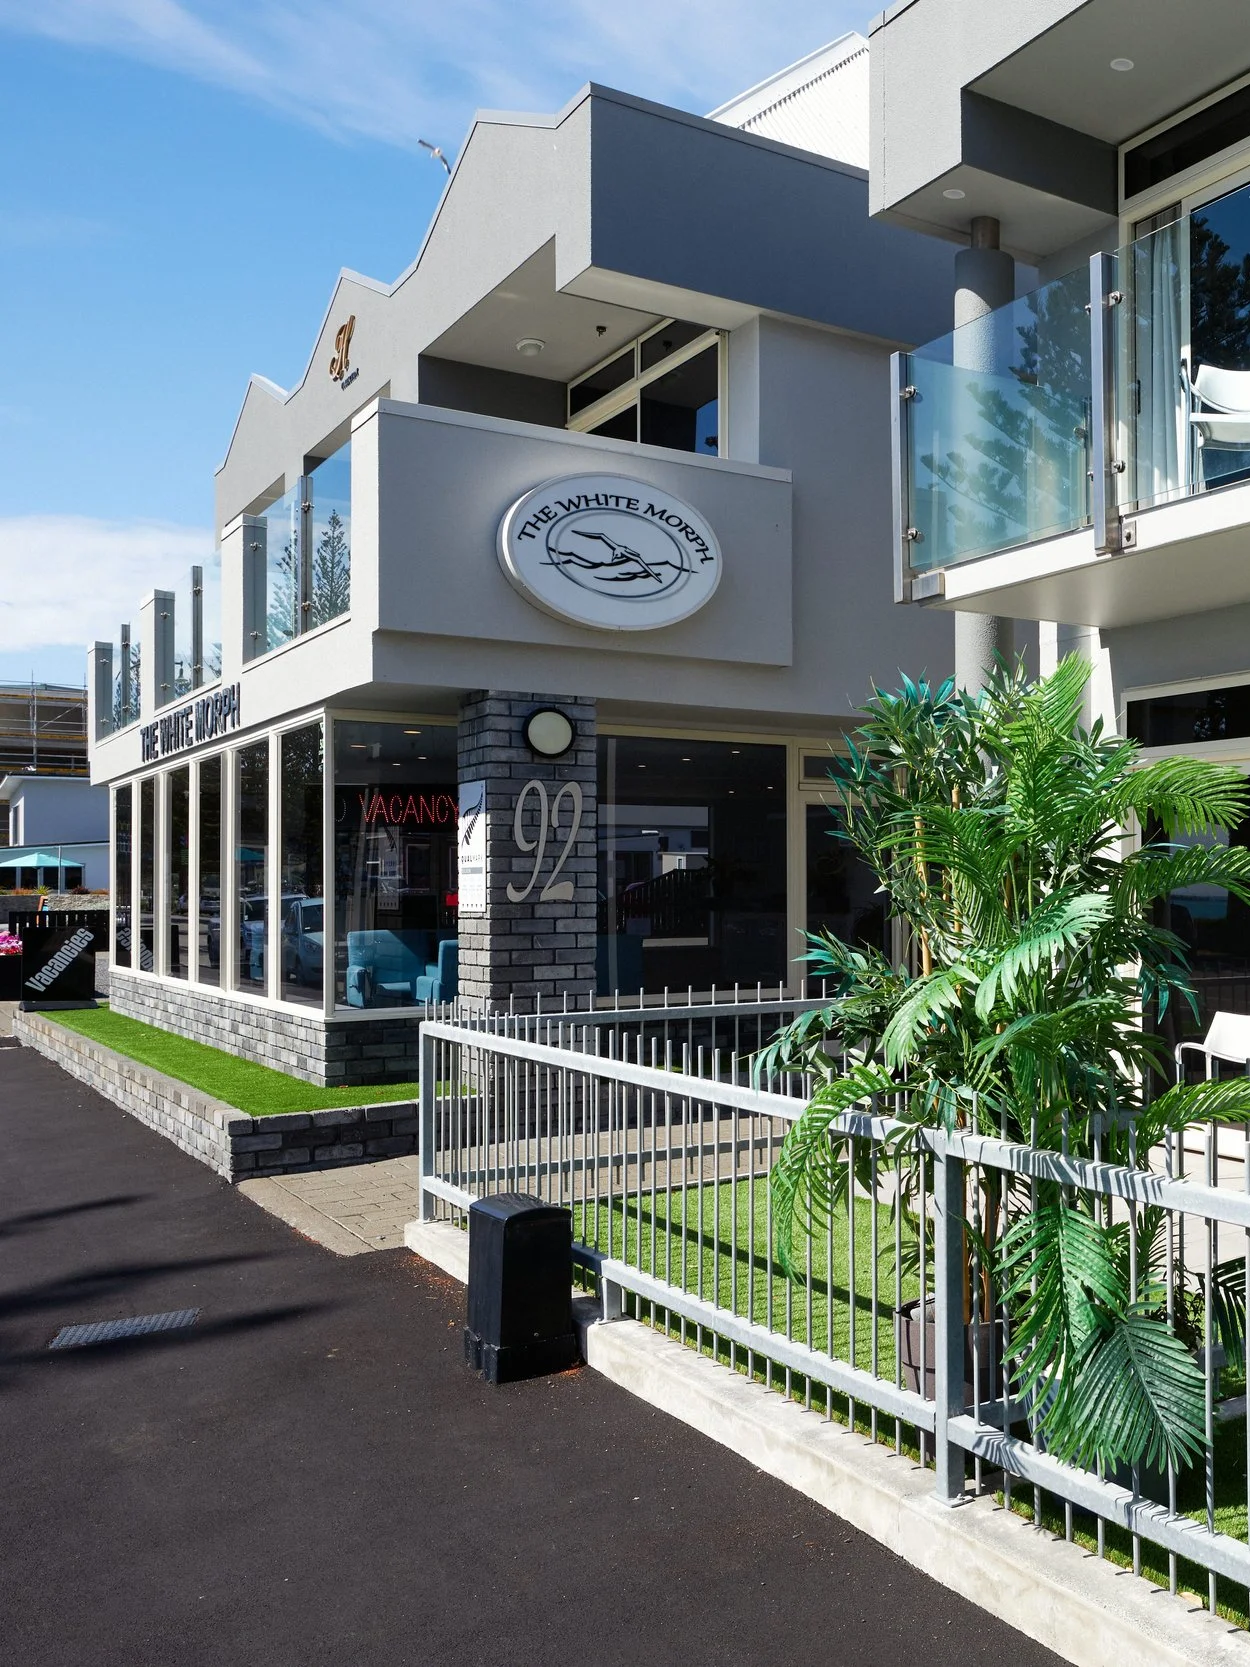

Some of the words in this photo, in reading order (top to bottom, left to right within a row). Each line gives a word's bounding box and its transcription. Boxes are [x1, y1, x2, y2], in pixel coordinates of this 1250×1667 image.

[517, 505, 558, 541] THE
[554, 493, 639, 512] WHITE
[644, 502, 715, 565] MORPH
[140, 721, 159, 763] THE
[159, 705, 193, 756] WHITE
[195, 681, 240, 743] MORPH
[358, 794, 459, 823] VACANCY
[506, 779, 583, 902] 92
[24, 927, 95, 992] Vacancies
